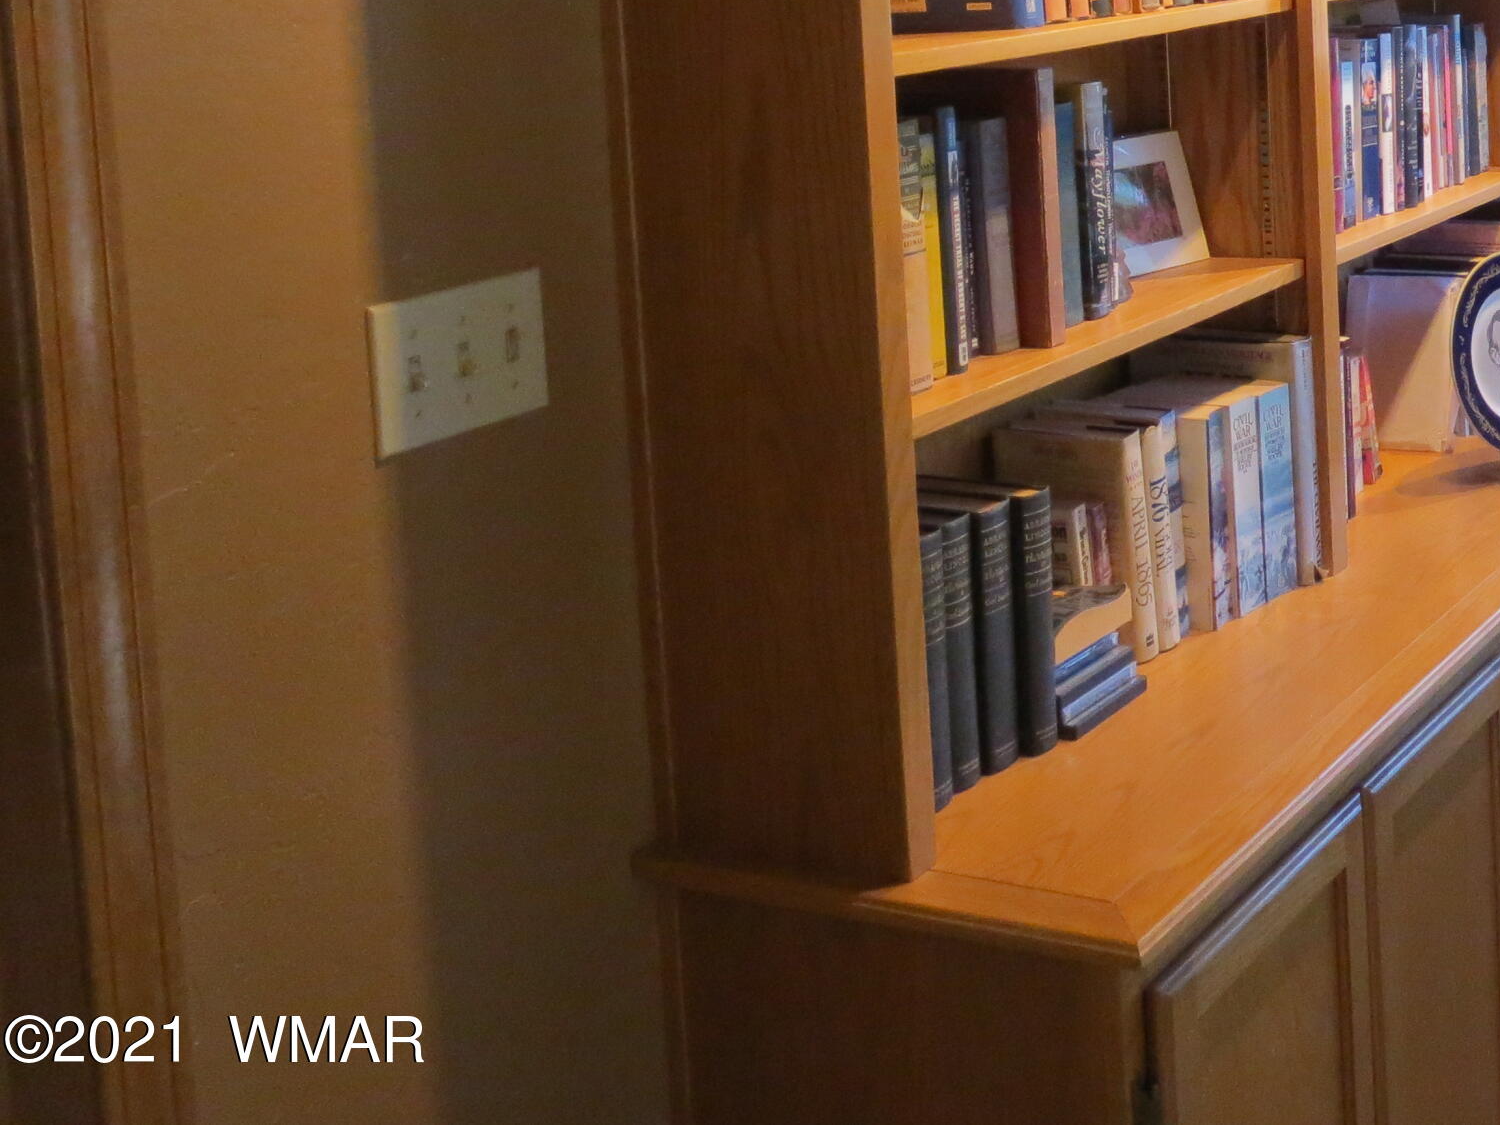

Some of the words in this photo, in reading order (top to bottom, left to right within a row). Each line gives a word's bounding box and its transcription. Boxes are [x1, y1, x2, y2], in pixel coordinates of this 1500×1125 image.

[1089, 127, 1107, 256] Mayflower
[1233, 411, 1254, 431] CIVIL
[1150, 476, 1168, 523] 1876
[1131, 496, 1149, 556] APRIL
[1136, 561, 1153, 607] 1865
